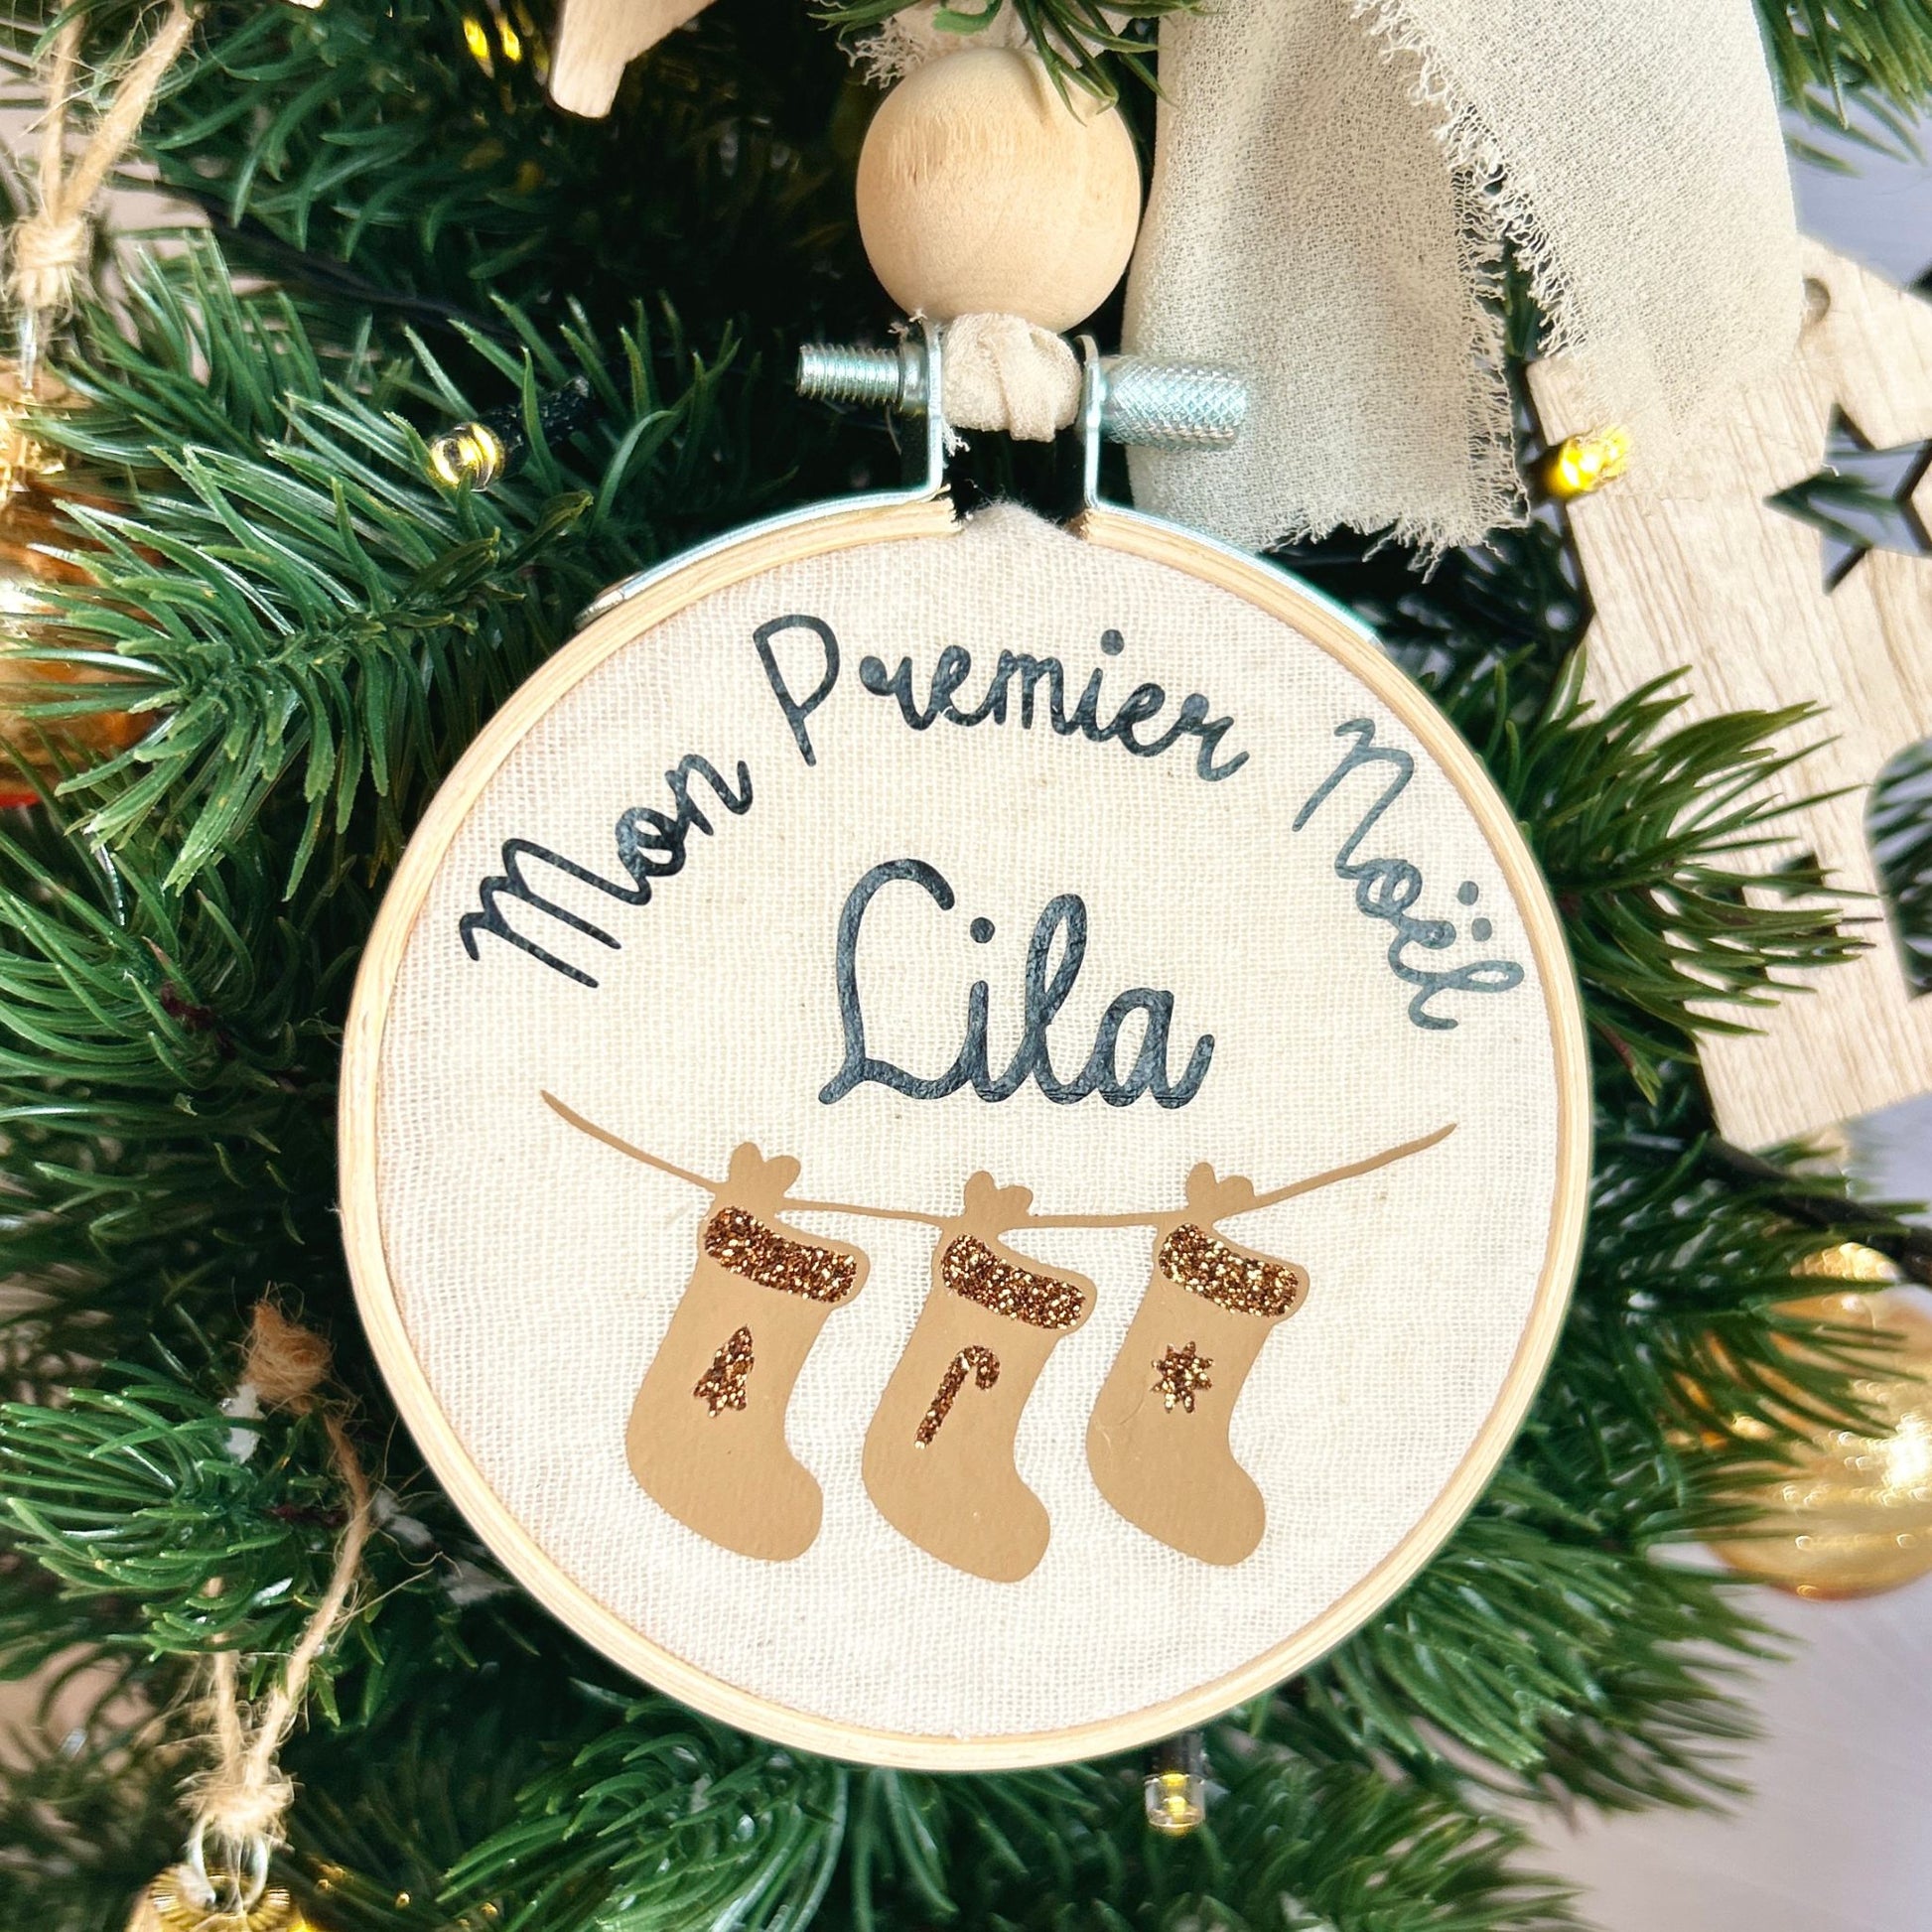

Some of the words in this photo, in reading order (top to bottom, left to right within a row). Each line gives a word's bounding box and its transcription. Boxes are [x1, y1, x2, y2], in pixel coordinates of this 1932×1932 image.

[458, 754, 755, 989] Mon
[752, 614, 1251, 782] Premier
[1291, 717, 1526, 1032] Noël
[817, 858, 1216, 1110] Lila
